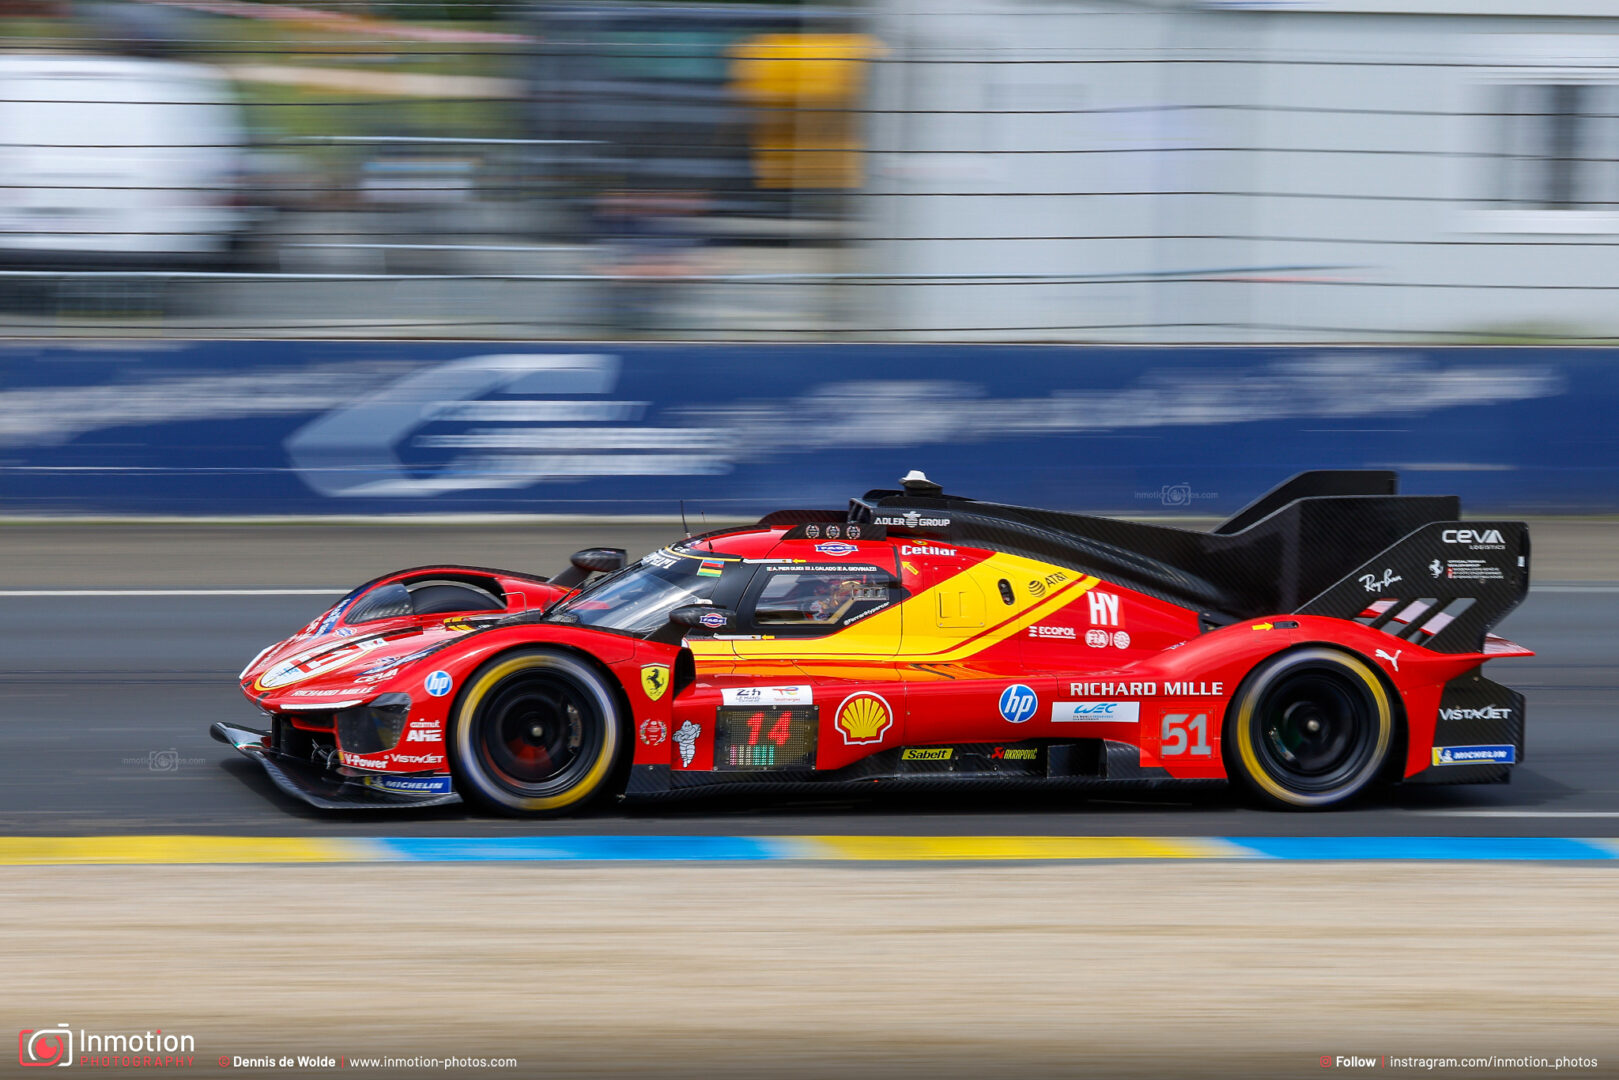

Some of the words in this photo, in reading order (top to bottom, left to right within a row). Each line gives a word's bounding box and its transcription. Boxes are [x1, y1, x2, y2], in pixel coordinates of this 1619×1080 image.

[874, 517, 905, 525] ADLER
[919, 518, 950, 527] GROUP
[901, 545, 958, 556] Cetilar
[1045, 572, 1069, 588] AT&T
[1086, 591, 1119, 626] HY
[1039, 626, 1075, 636] ECOPOL
[427, 673, 448, 695] hp
[1070, 682, 1157, 696] RICHARD
[1164, 681, 1223, 695] MILLE
[290, 689, 340, 697] RICHARD
[340, 685, 378, 696] MILLE
[1004, 685, 1033, 721] hp
[1074, 703, 1118, 713] WEC
[1438, 704, 1512, 721] VISTAJET
[746, 710, 792, 746] 14
[1161, 713, 1212, 755] 51
[406, 729, 442, 742] AHE
[344, 753, 388, 769] V-Power
[390, 752, 444, 764] VISTAJET
[906, 749, 948, 760] Sabelt
[1454, 750, 1507, 760] MICHELIN
[386, 780, 443, 789] MICHELIN
